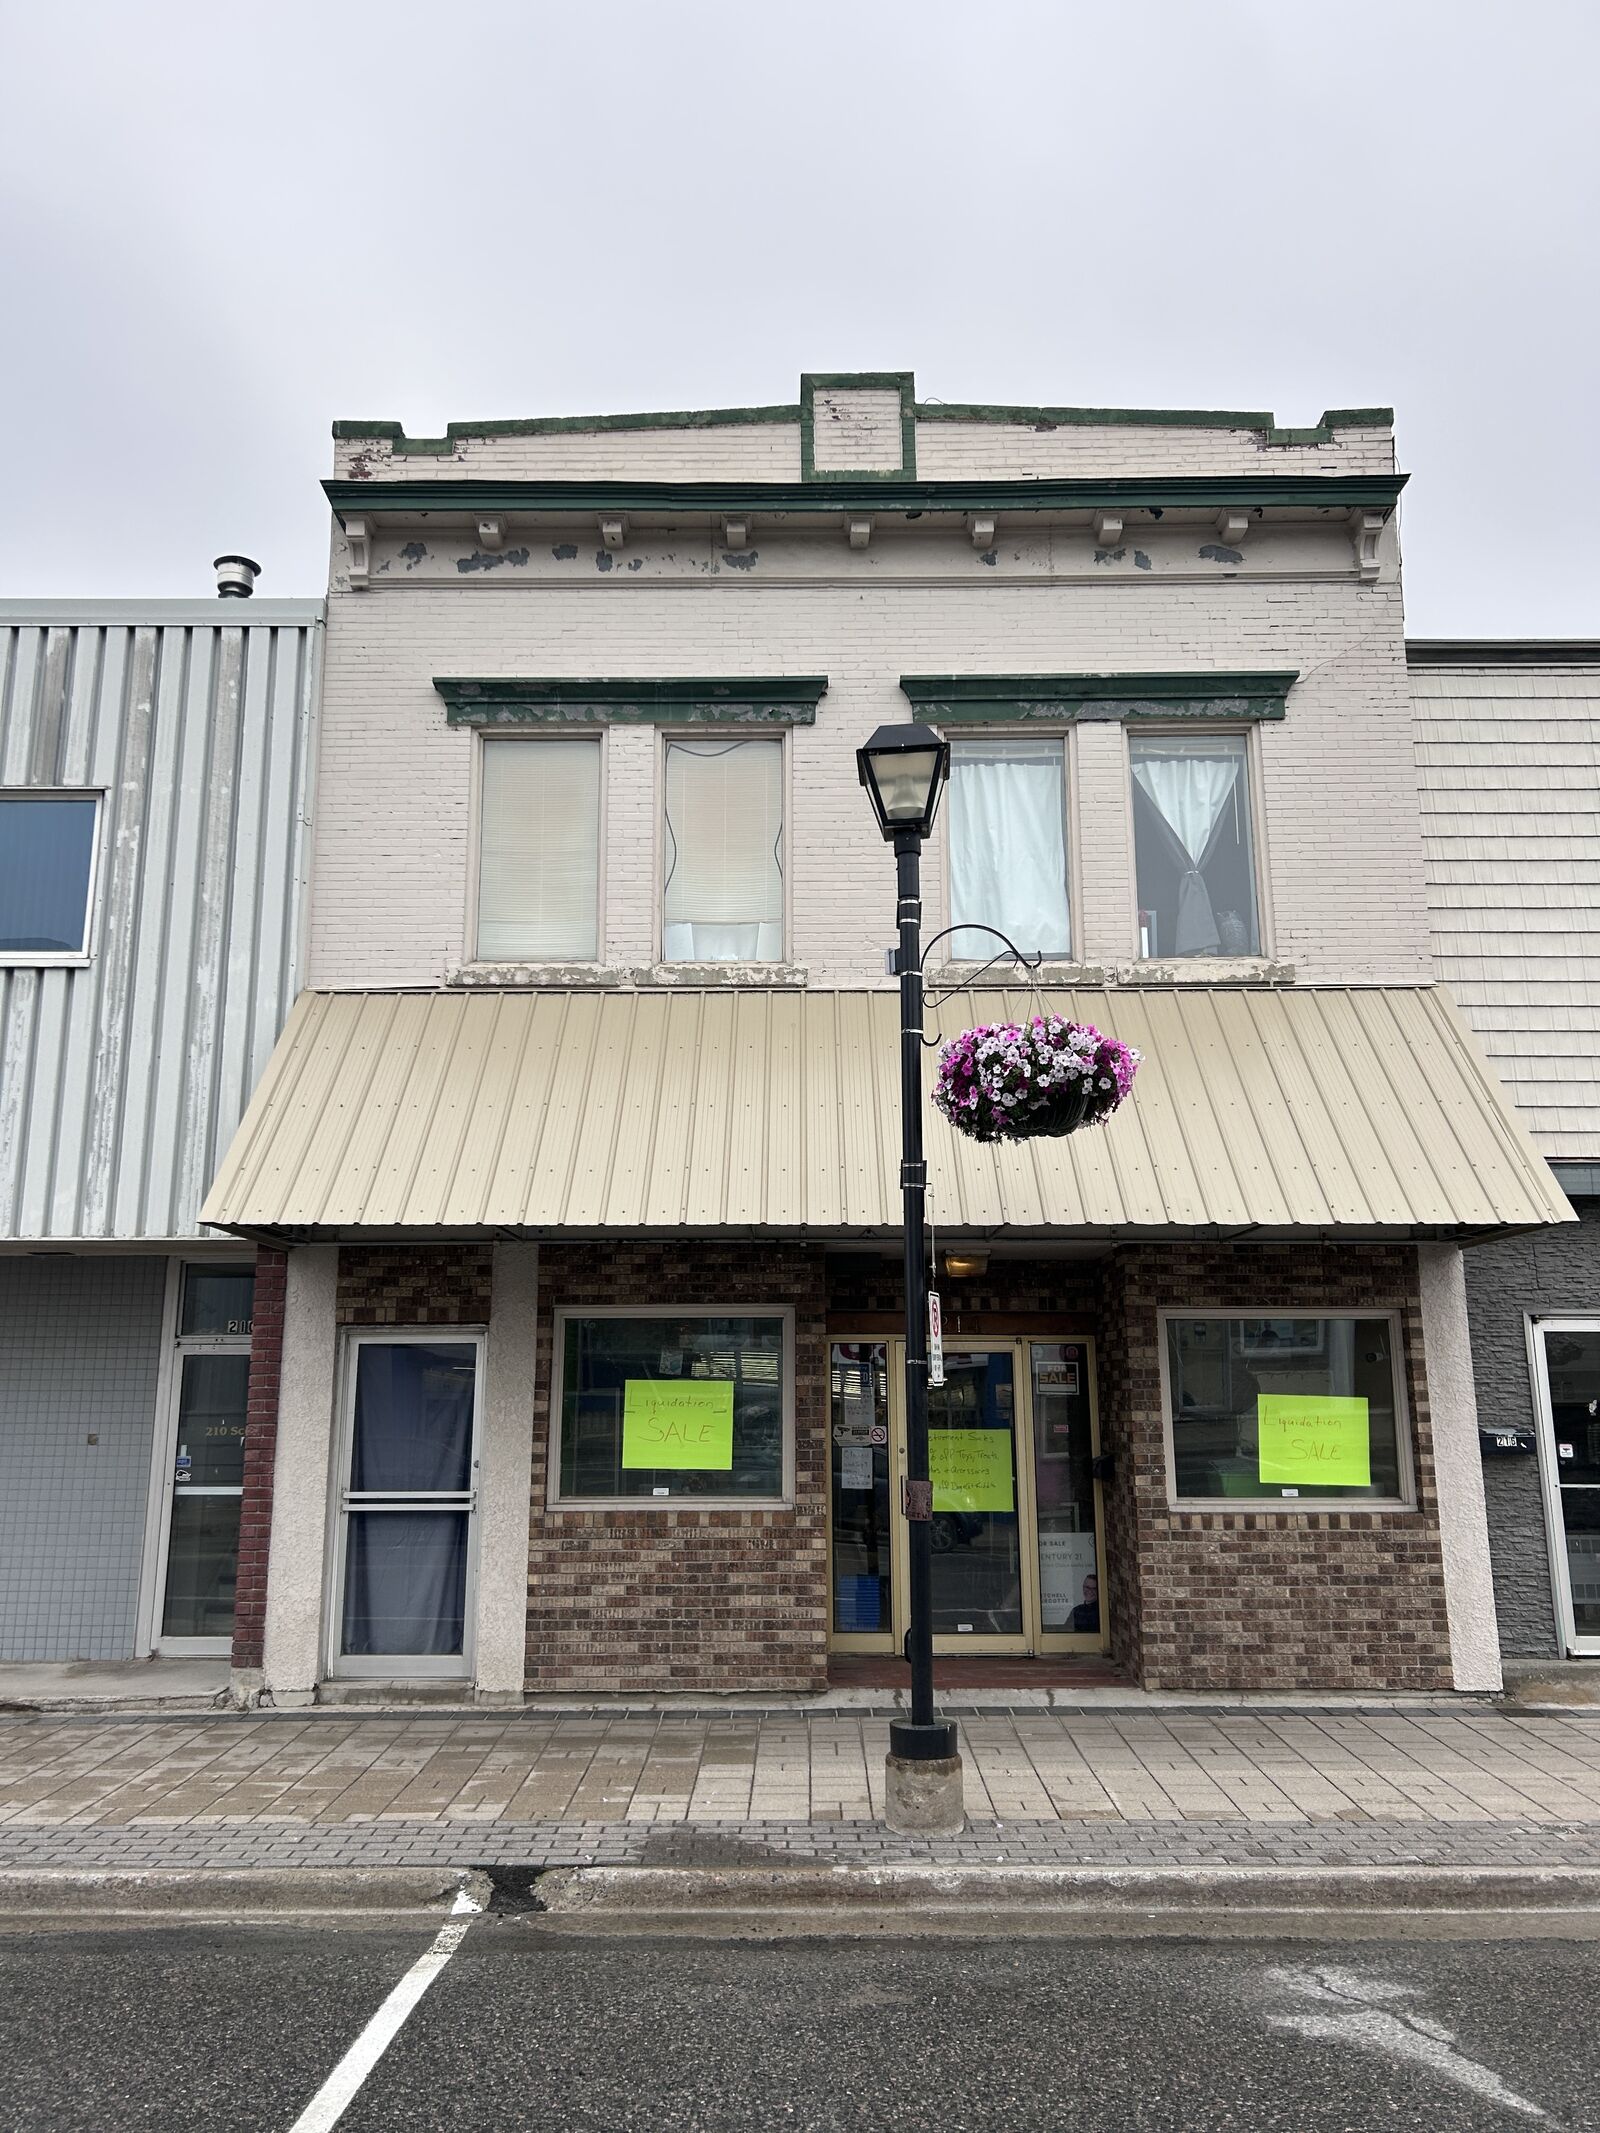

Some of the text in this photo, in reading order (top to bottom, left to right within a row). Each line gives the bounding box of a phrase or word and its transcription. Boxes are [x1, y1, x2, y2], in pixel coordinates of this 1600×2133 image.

[1047, 1365, 1067, 1373] FOR
[1040, 1373, 1075, 1384] SALE
[629, 1388, 714, 1415] Liquidation
[1263, 1405, 1342, 1432] Liquidation
[206, 1426, 228, 1437] 210
[637, 1417, 715, 1447] SALE
[1287, 1438, 1343, 1461] SALE
[1041, 1553, 1082, 1561] ENTURY 21
